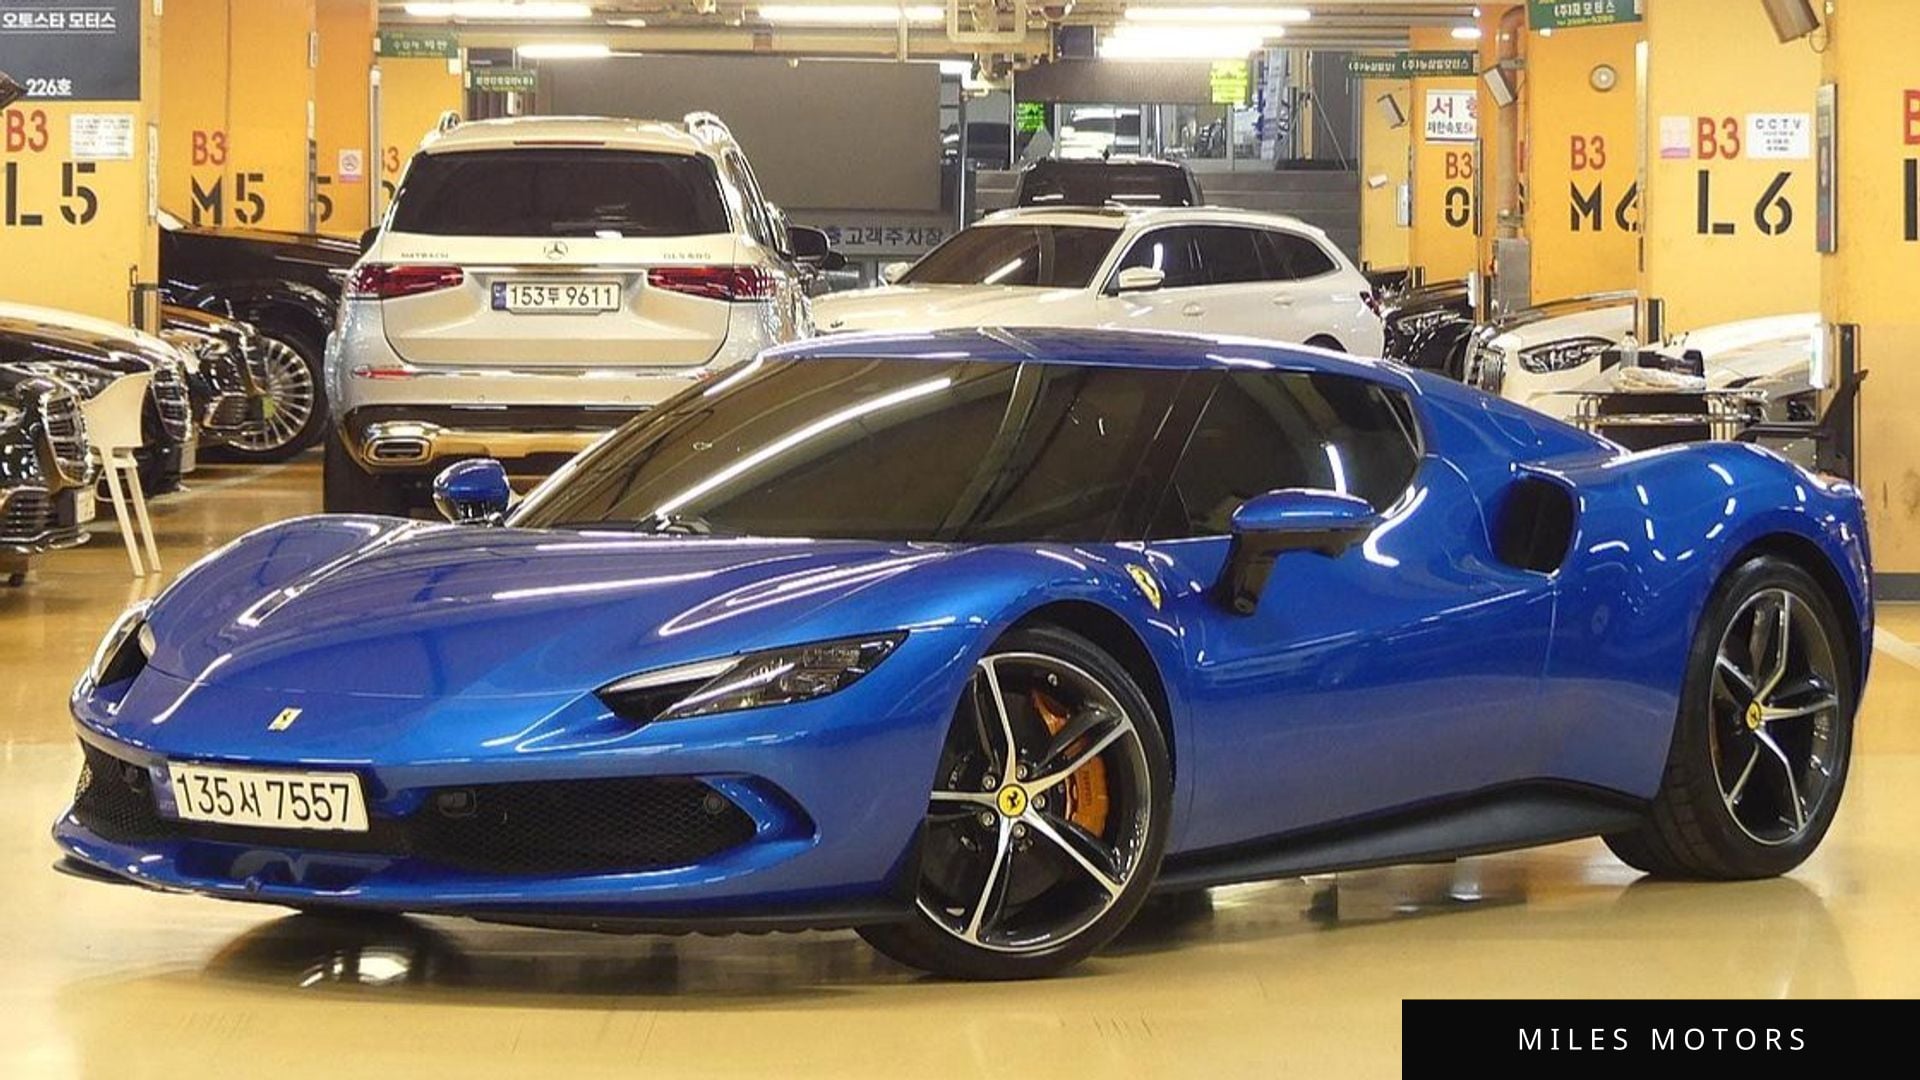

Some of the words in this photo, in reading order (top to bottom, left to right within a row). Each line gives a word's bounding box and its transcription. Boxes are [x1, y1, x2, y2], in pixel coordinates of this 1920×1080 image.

[68, 12, 116, 29] 모터스
[26, 77, 72, 96] 226호
[6, 109, 48, 152] B3
[1697, 116, 1740, 160] B3
[192, 131, 227, 166] B3
[382, 146, 400, 173] 3
[1571, 135, 1606, 171] B3
[1446, 152, 1472, 180] B3
[510, 286, 560, 306] 153두
[566, 286, 612, 306] 9611
[176, 773, 262, 818] 135서
[265, 780, 350, 823] 7557
